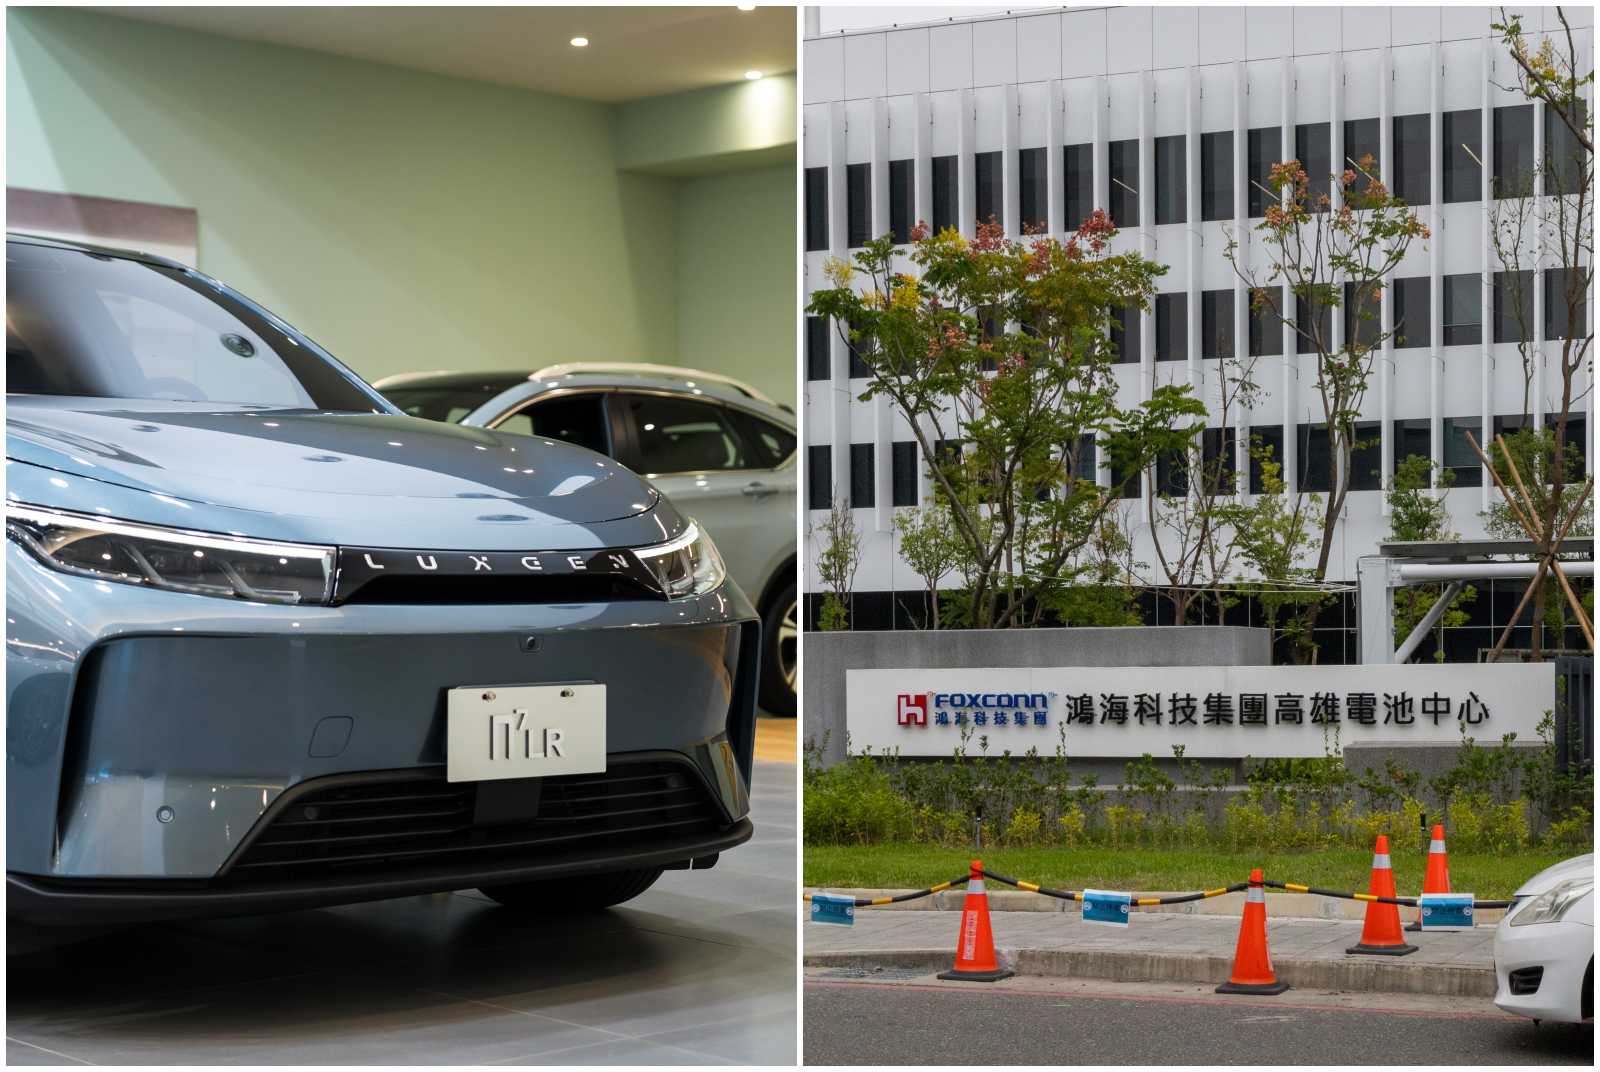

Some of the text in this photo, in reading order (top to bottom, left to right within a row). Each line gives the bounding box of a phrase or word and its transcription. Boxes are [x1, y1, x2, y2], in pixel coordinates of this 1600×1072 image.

[364, 553, 630, 571] LUXGEN
[1065, 692, 1490, 726] 鴻海科技集團高雄電池中心
